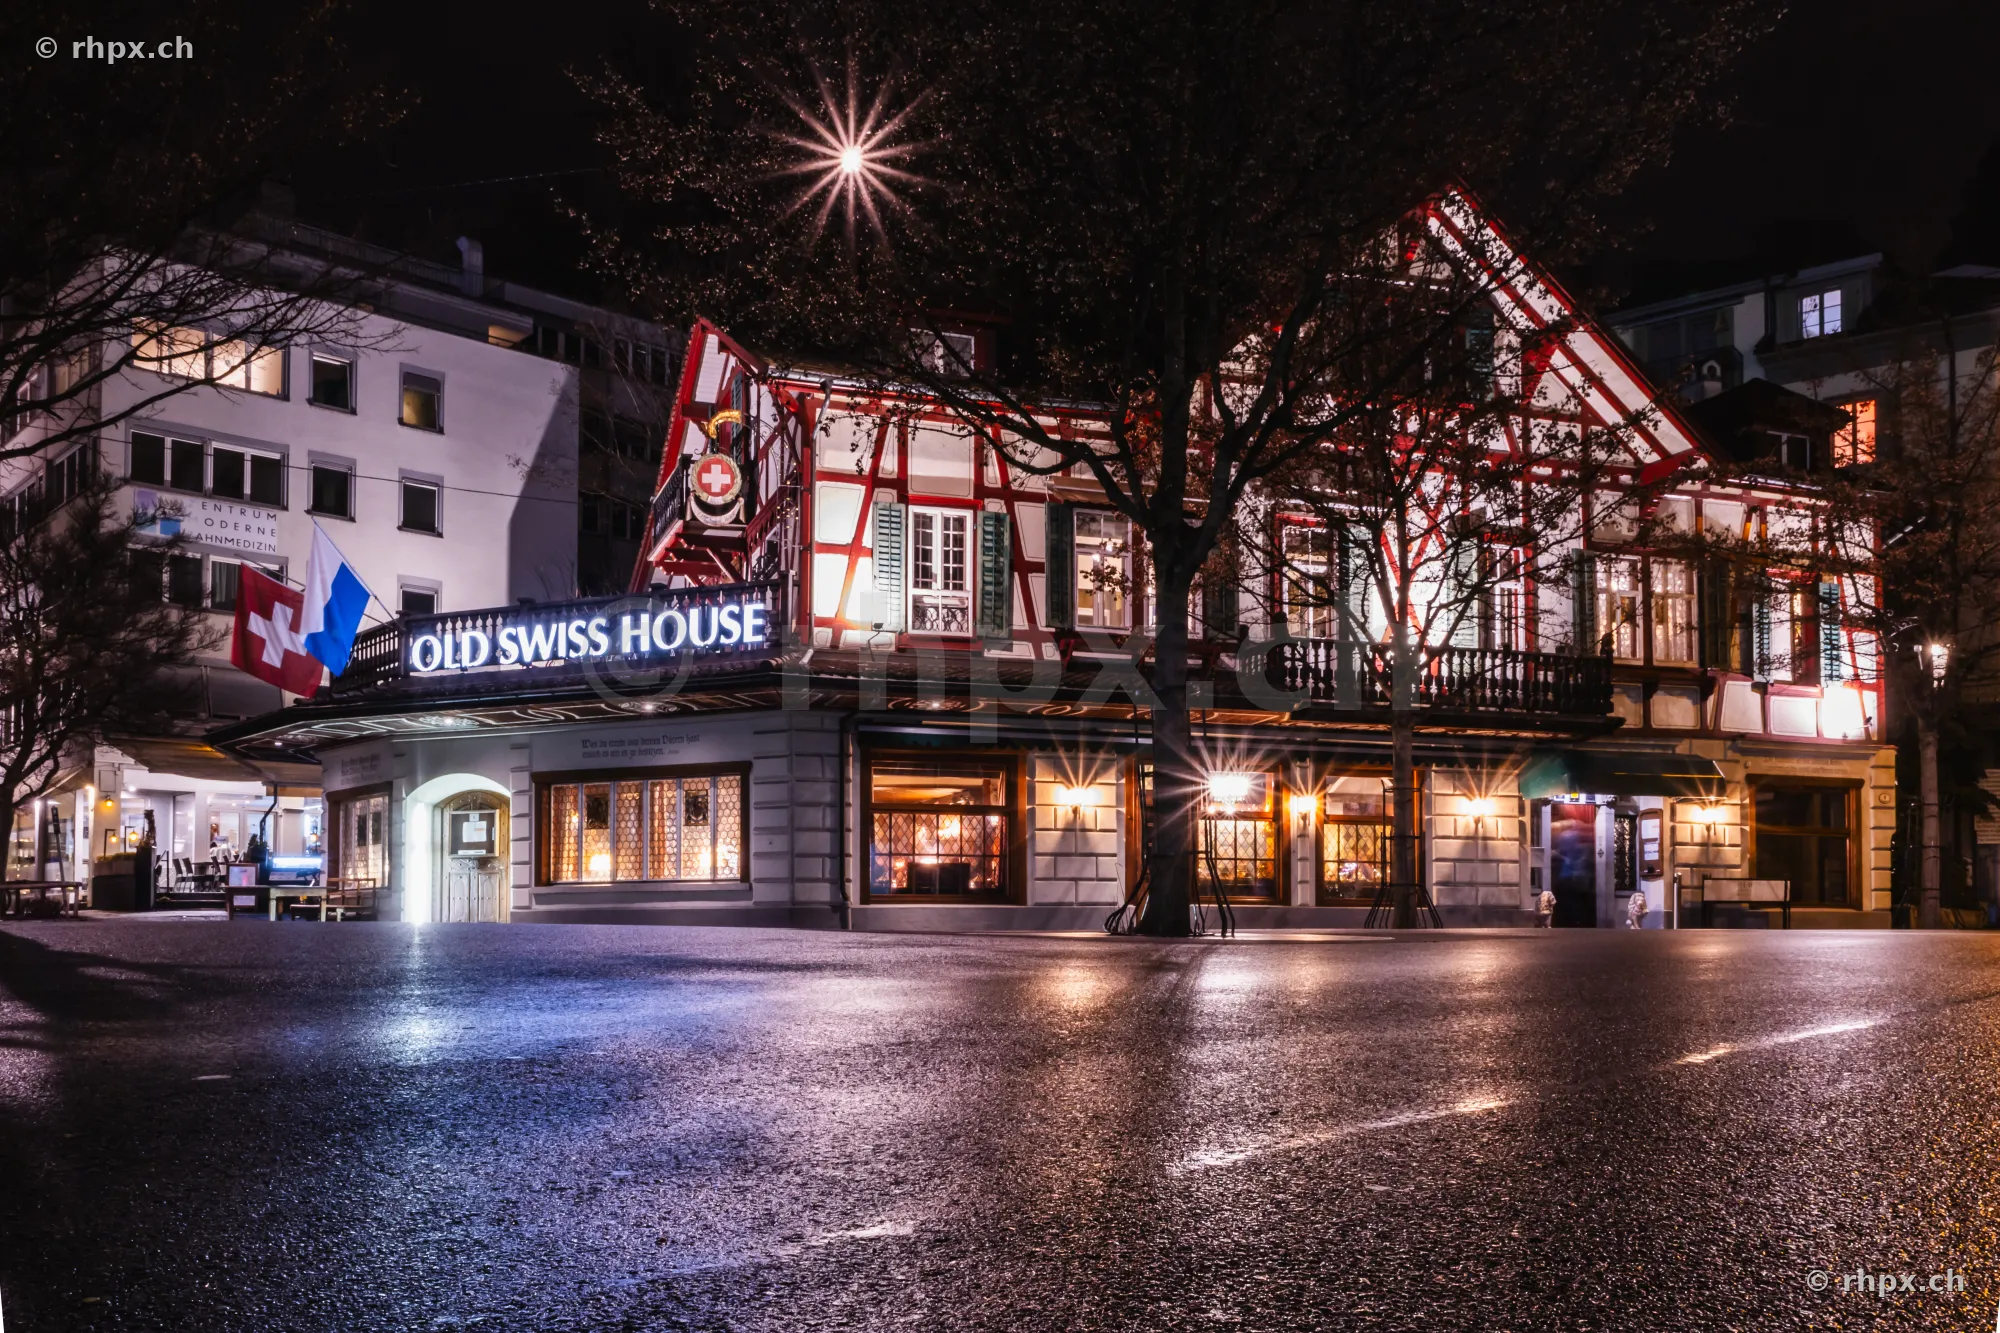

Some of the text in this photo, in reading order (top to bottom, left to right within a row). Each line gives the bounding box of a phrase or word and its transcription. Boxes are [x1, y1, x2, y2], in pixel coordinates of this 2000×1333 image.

[188, 516, 276, 537] ODERNE
[187, 531, 276, 552] AHNMEDIZIN
[412, 603, 766, 672] OLD SWISS HOUSE
